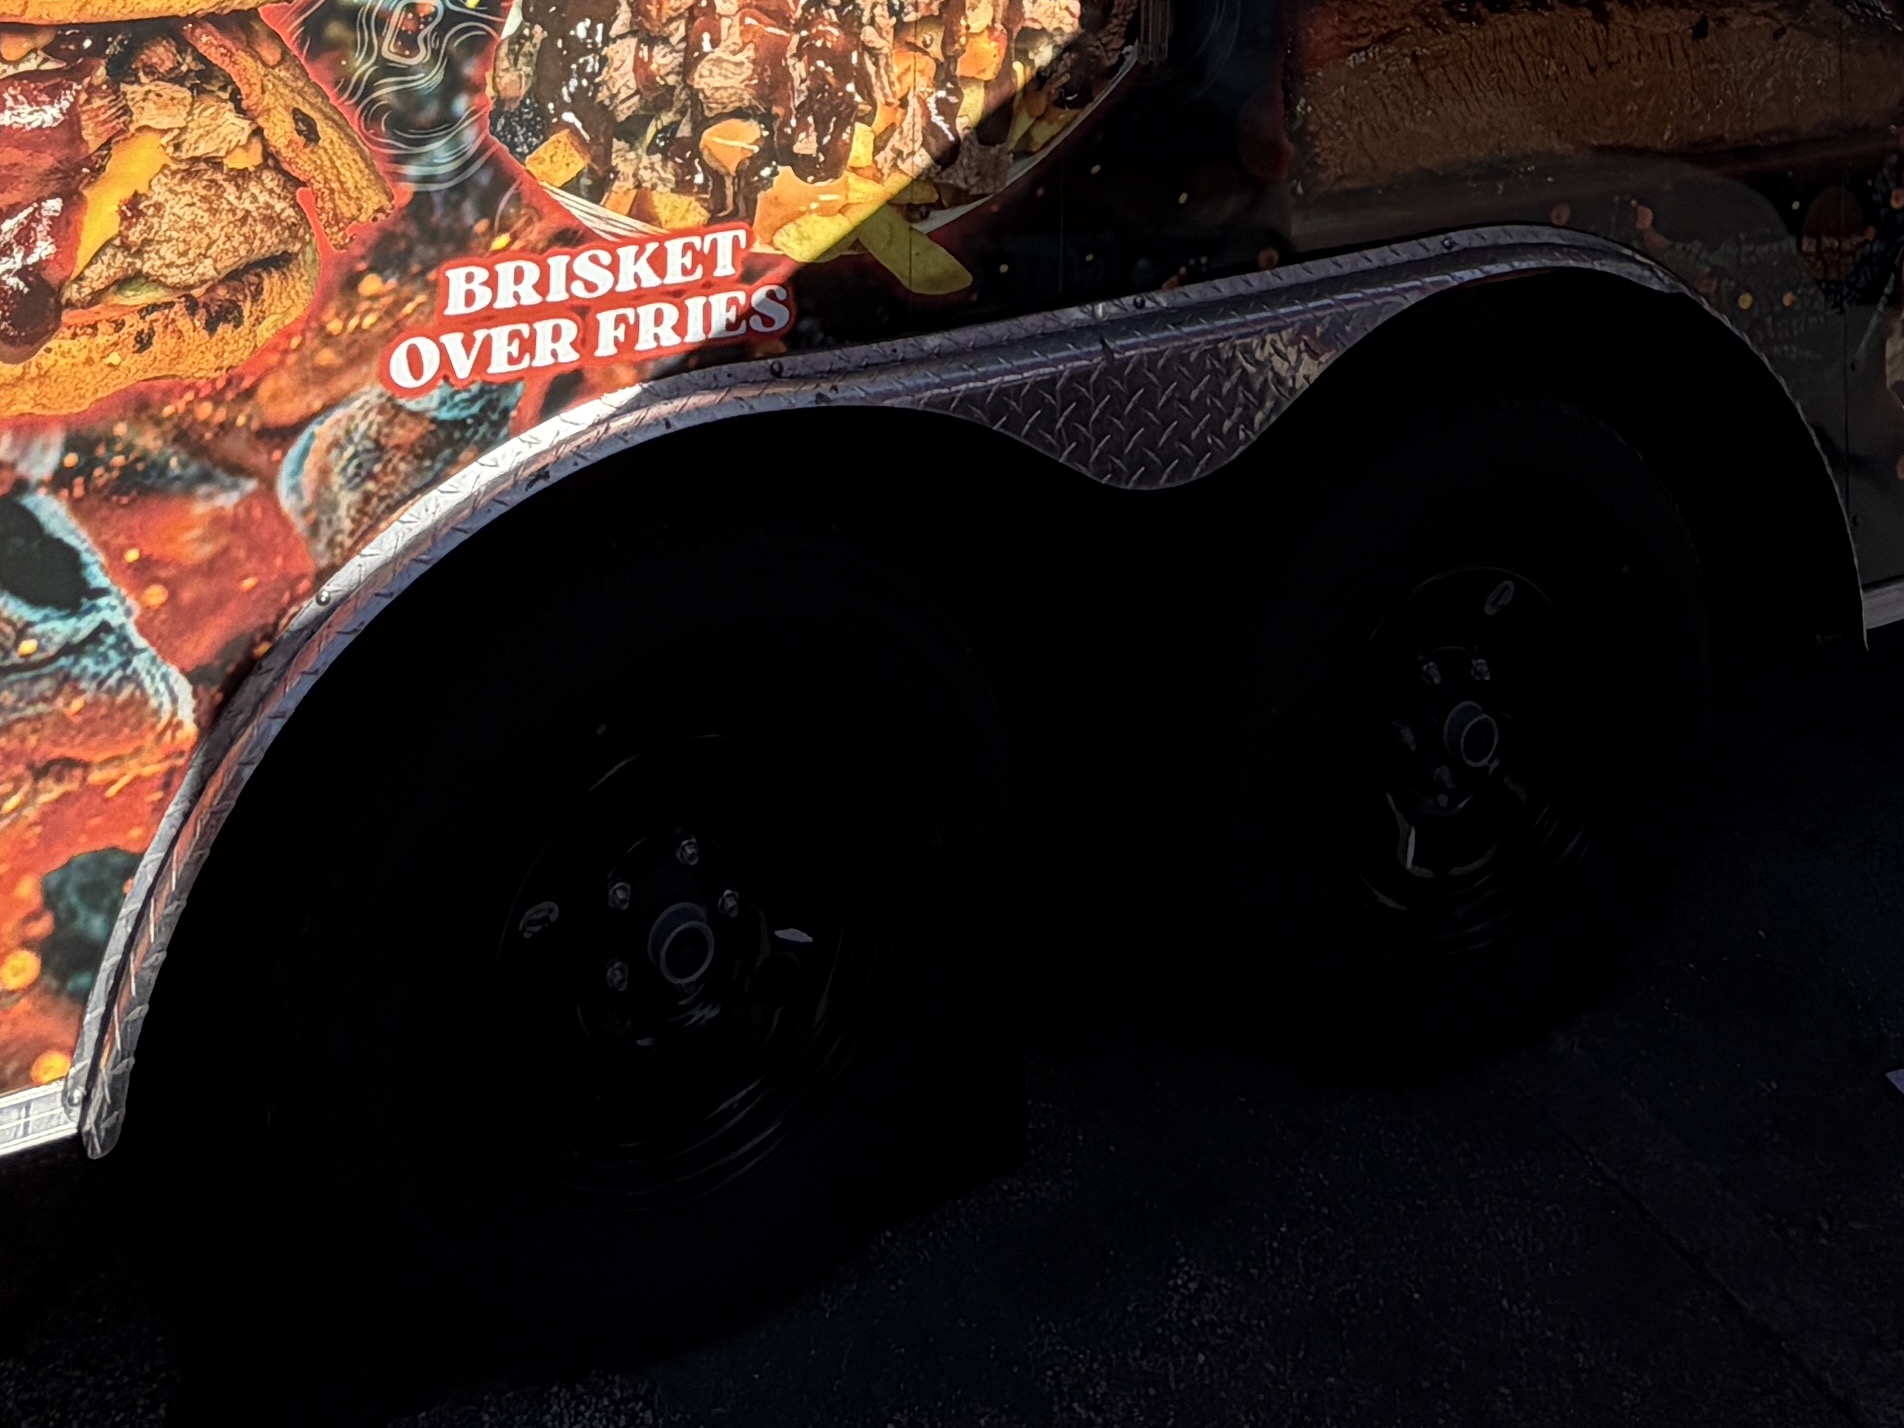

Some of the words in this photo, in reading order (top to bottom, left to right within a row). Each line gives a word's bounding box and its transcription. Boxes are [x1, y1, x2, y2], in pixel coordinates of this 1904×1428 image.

[443, 229, 751, 317] BRISKET
[388, 320, 582, 391] OVER
[596, 285, 794, 365] FRIES
